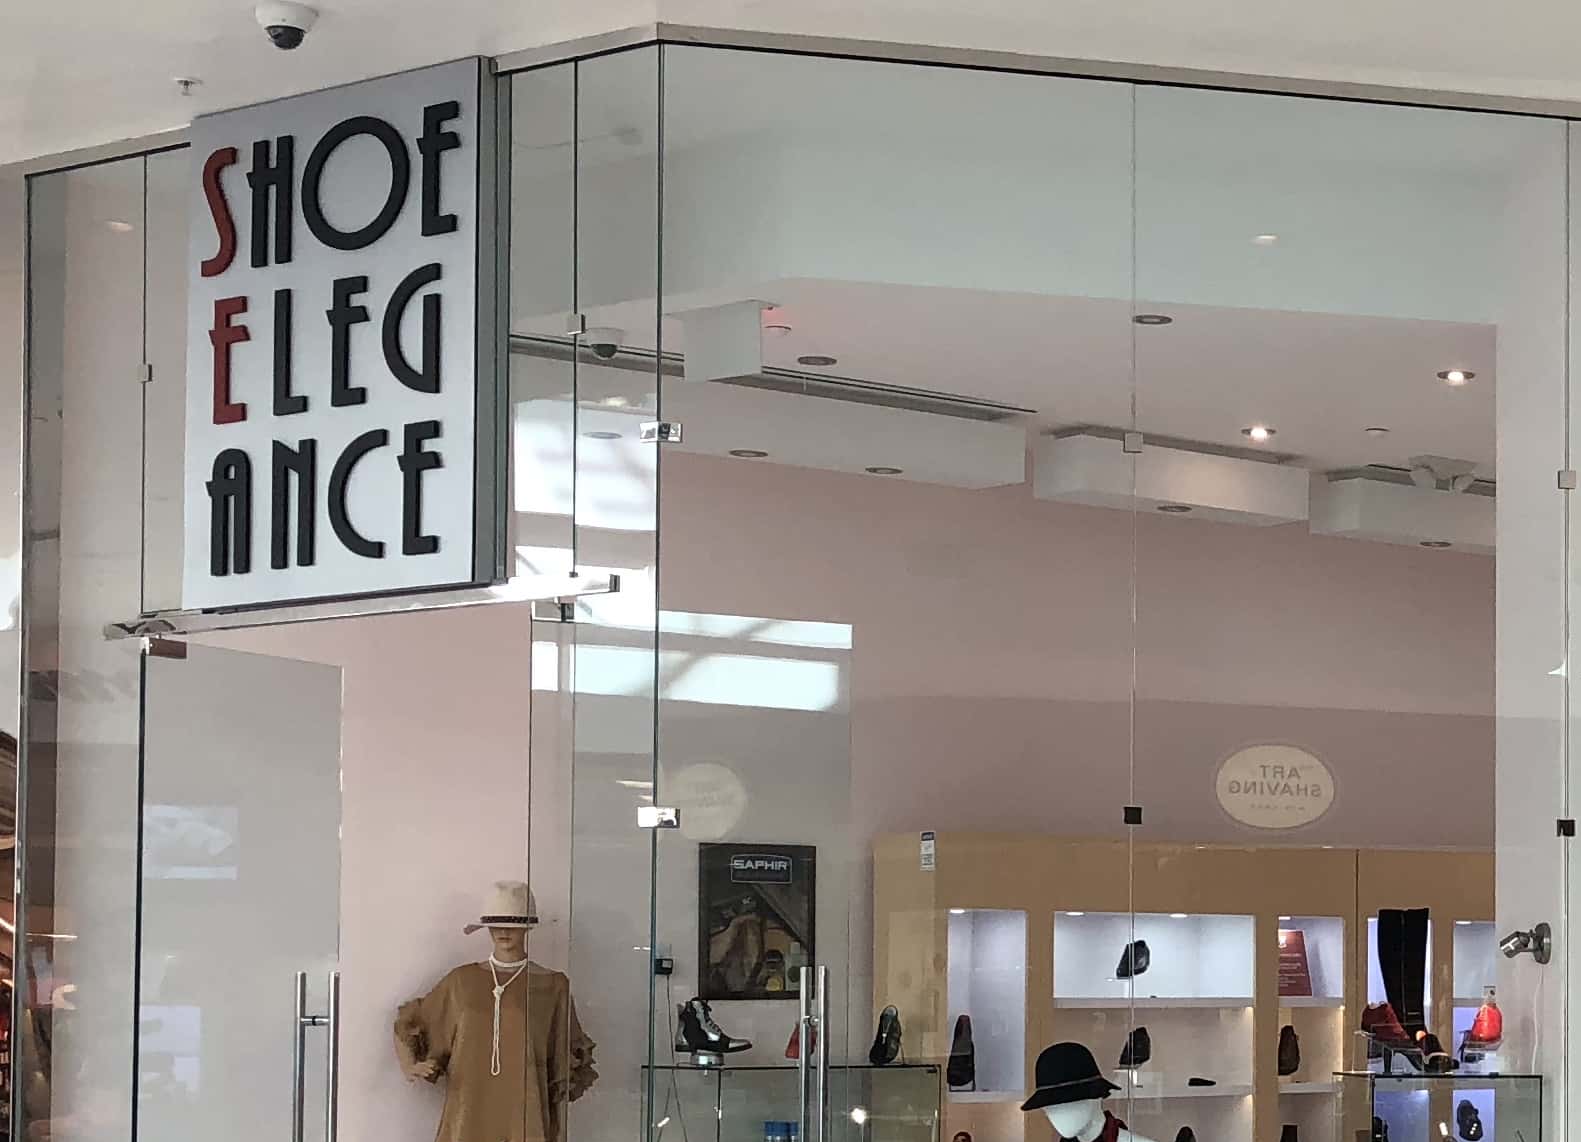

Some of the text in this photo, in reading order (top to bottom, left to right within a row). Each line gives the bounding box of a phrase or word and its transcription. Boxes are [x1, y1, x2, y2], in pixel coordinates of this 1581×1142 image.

[201, 101, 462, 278] SHOE
[208, 262, 443, 426] ELEG
[205, 420, 444, 577] ANCE
[733, 859, 788, 871] SAPHIR
